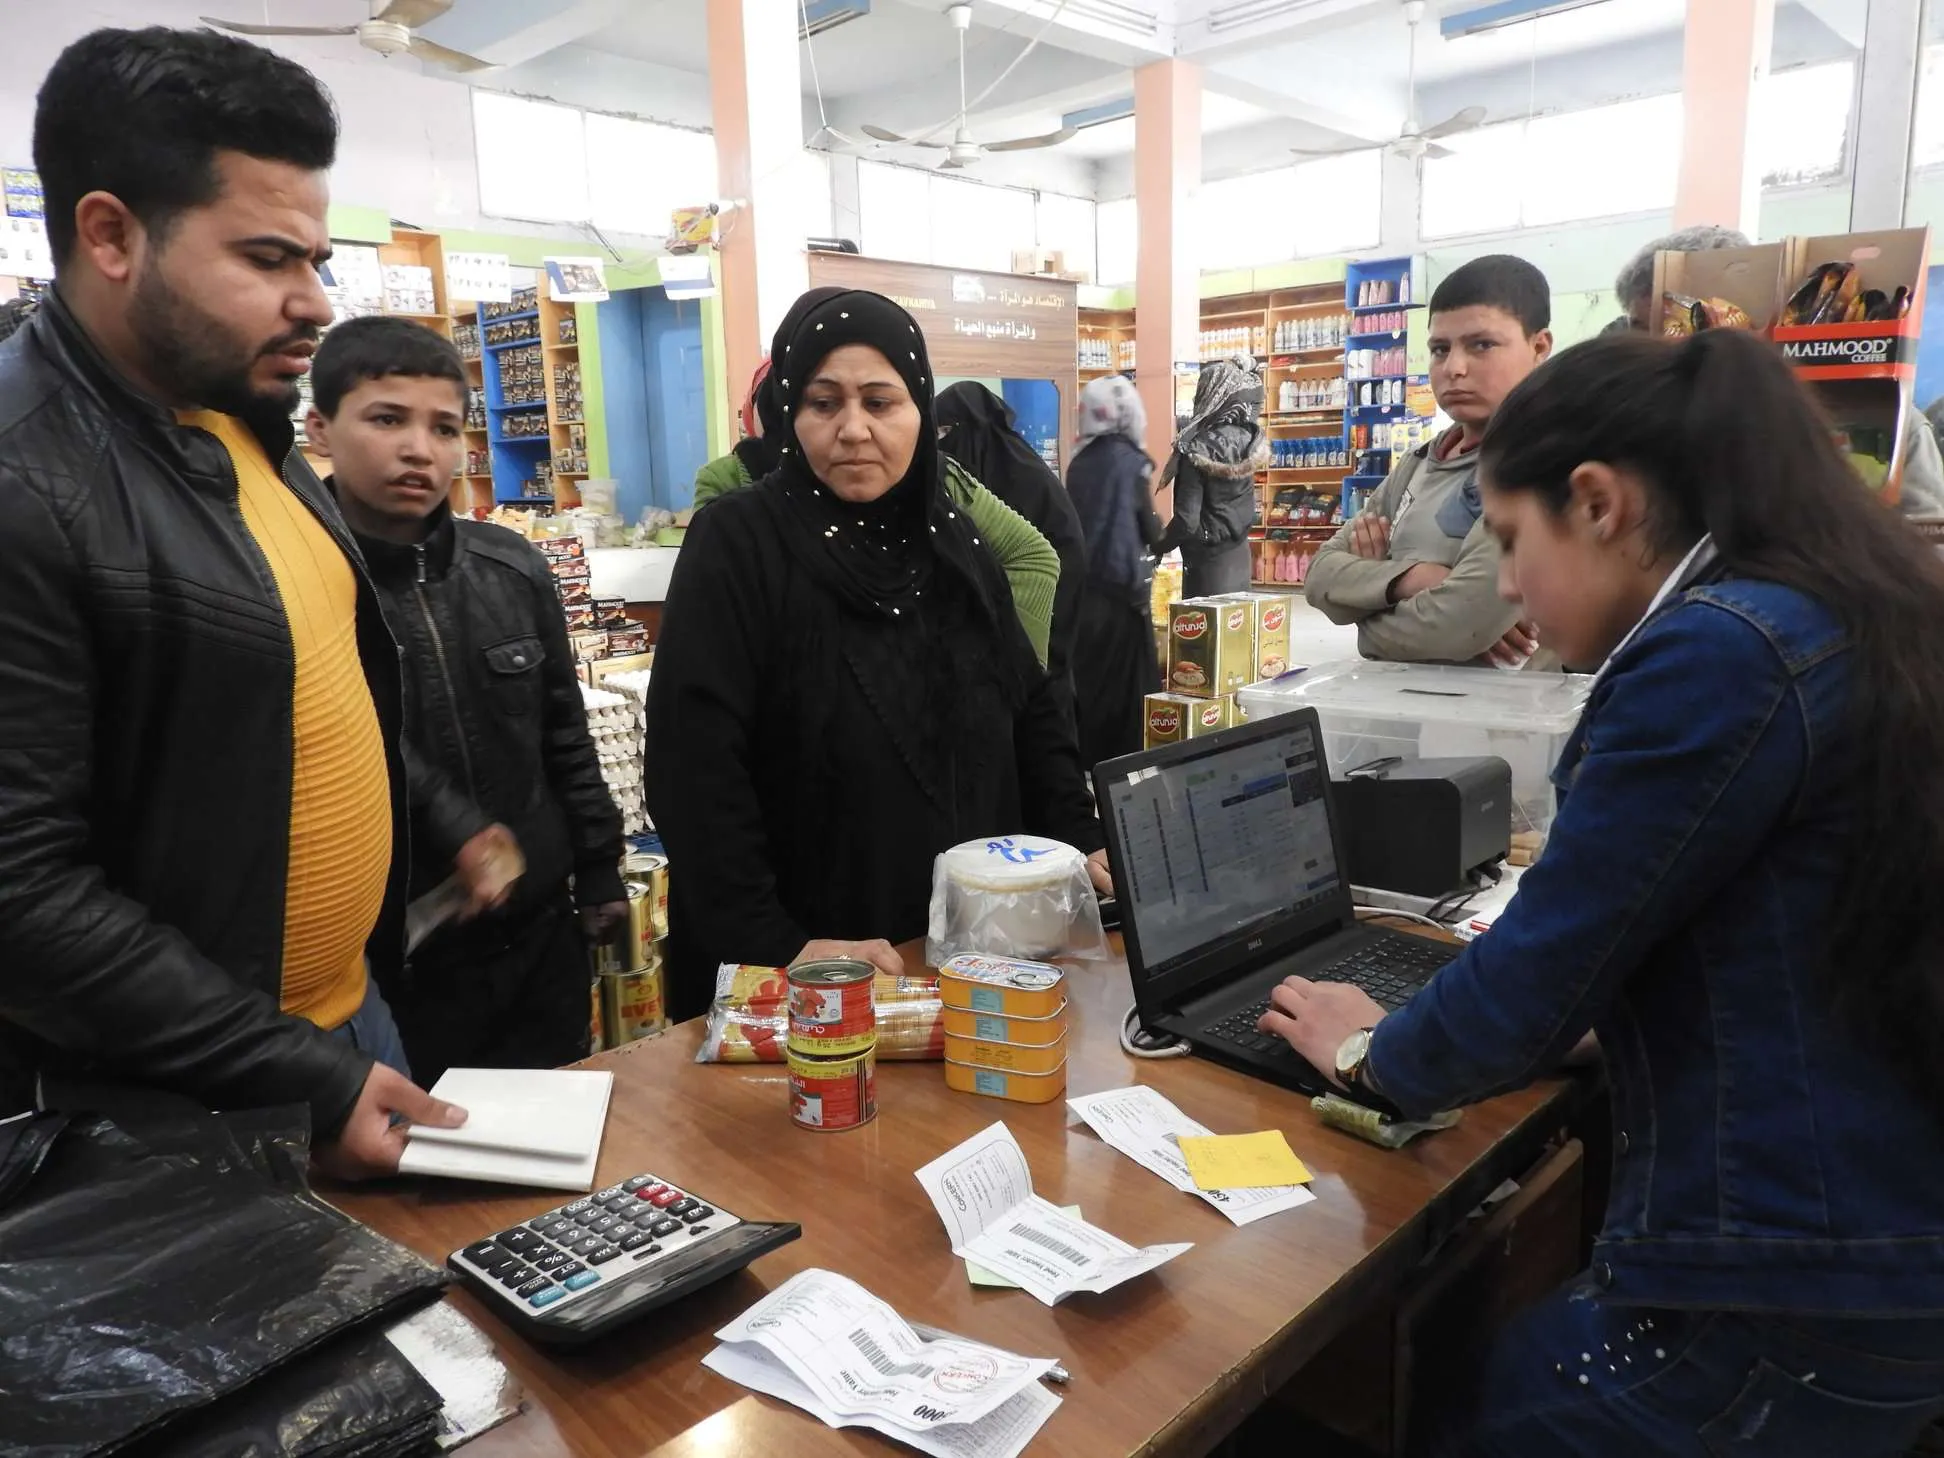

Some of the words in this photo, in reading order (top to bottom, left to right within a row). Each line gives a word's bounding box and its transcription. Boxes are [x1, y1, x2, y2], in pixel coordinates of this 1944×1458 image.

[954, 317, 985, 336] الحياة
[1783, 339, 1888, 358] MAHMOOD
[1851, 352, 1887, 363] COFFEE
[839, 1369, 858, 1391] Value
